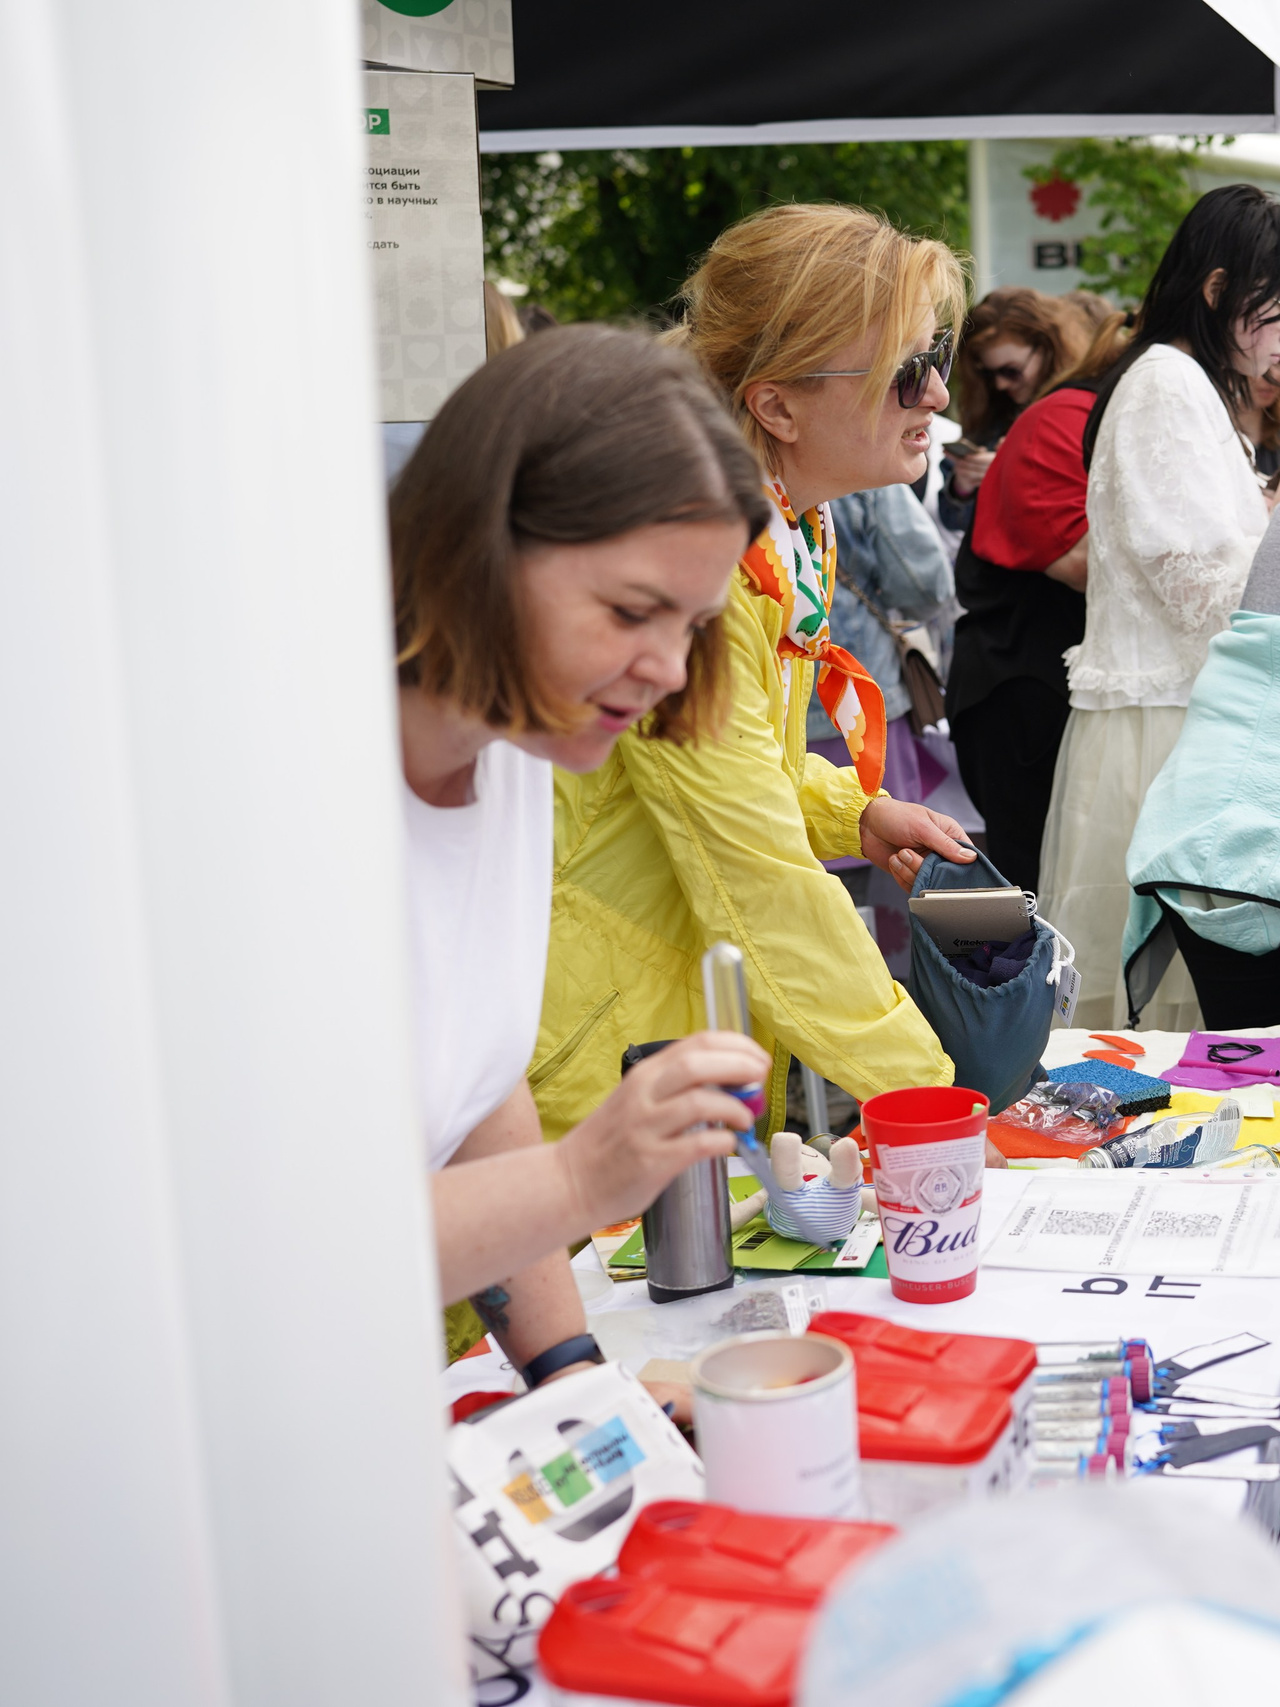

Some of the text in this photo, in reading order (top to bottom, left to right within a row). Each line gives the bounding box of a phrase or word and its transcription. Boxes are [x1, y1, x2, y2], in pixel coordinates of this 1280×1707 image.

[391, 181, 421, 190] быть
[377, 197, 384, 205] в
[387, 197, 438, 207] научных
[884, 1206, 981, 1257] Bud
